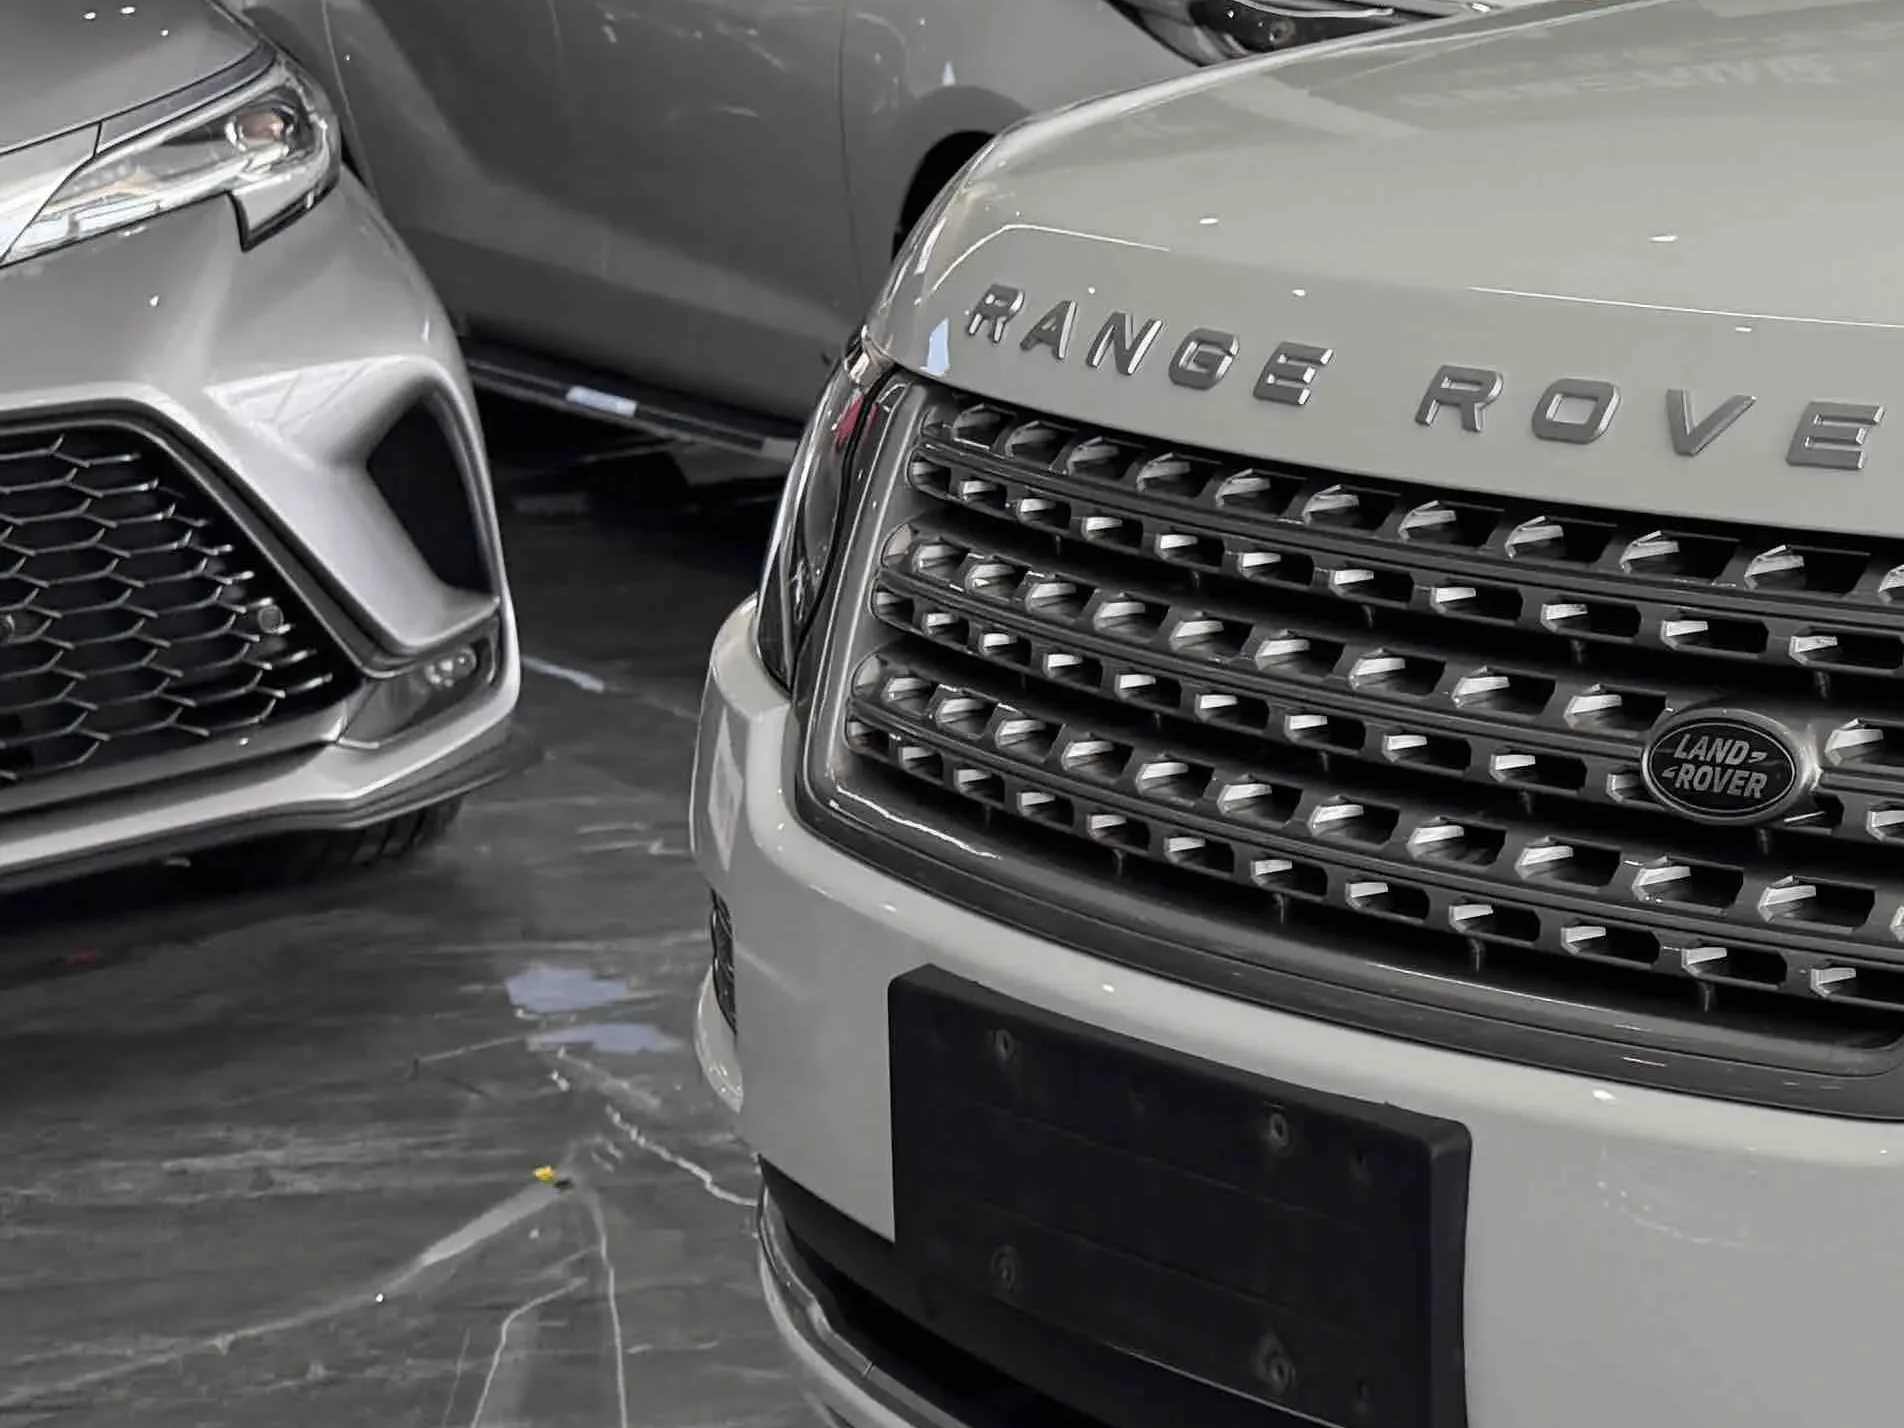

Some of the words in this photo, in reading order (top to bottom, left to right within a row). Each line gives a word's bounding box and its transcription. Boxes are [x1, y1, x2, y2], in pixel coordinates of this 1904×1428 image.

[965, 283, 1333, 405] RANGE
[1674, 734, 1751, 766] LAND
[1675, 763, 1768, 799] ROVER
